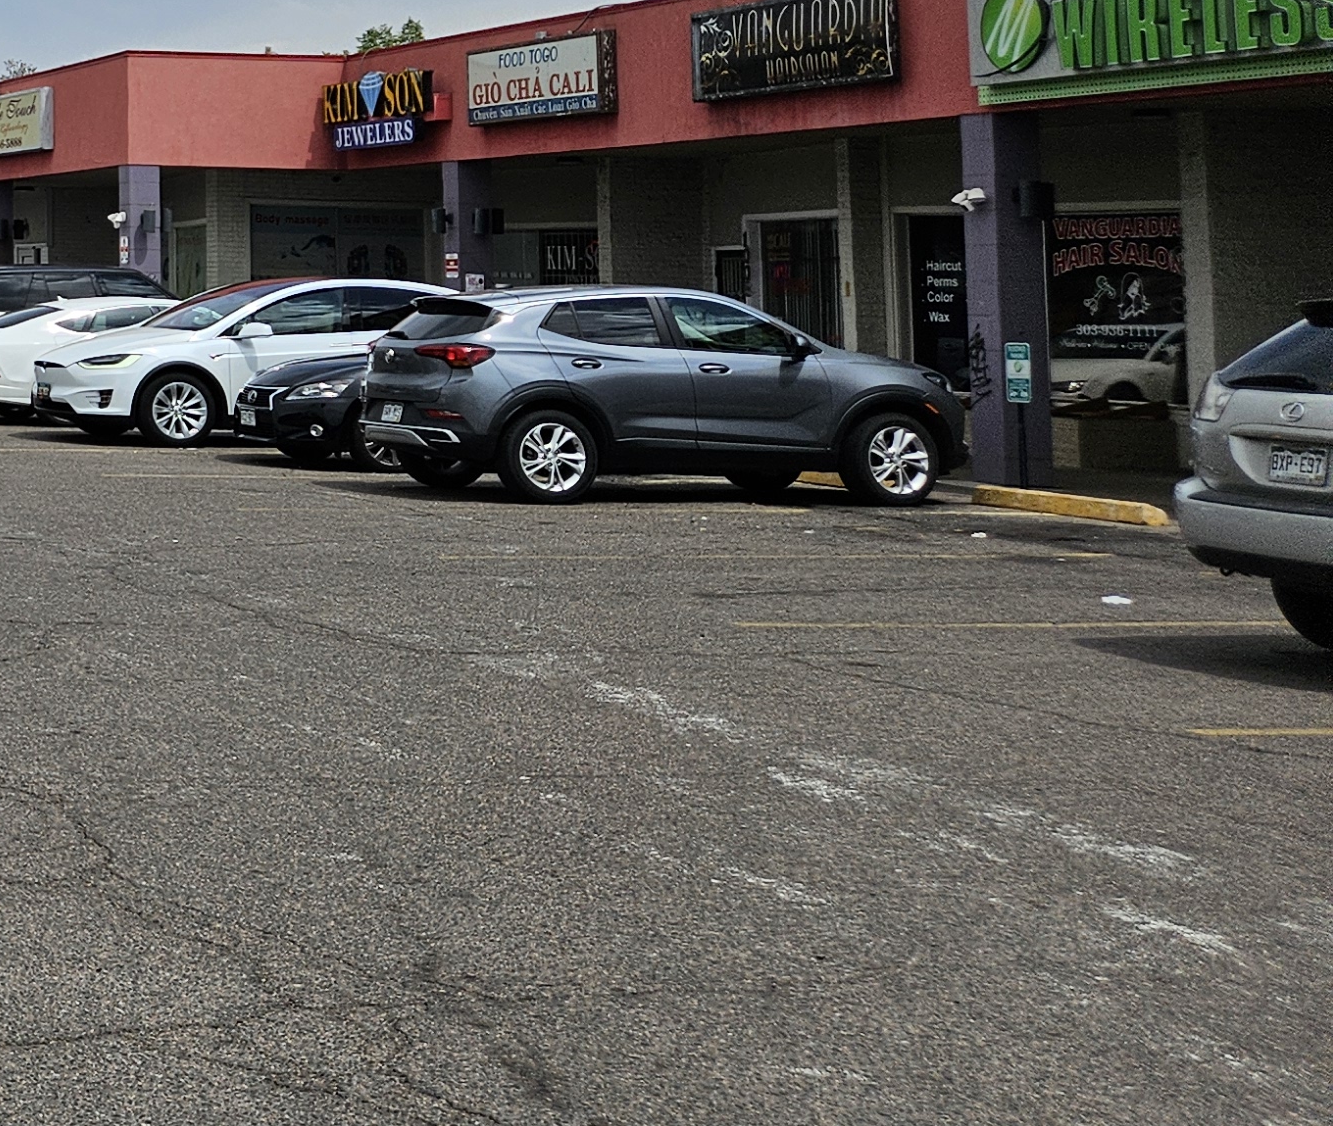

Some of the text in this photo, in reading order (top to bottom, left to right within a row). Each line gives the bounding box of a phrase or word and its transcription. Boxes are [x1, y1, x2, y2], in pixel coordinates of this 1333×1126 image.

[498, 45, 559, 69] FOOD TOGO
[472, 66, 595, 106] GIÒ CHẢ CALI
[6, 95, 37, 120] Touch
[322, 80, 359, 124] KIM
[335, 119, 414, 148] JEWELERS
[1052, 215, 1182, 240] VANGUARDIA
[926, 259, 962, 271] Haircut
[1052, 242, 1104, 277] HAIR
[926, 275, 959, 287] Perms
[927, 290, 954, 303] Color
[928, 311, 950, 323] Wax
